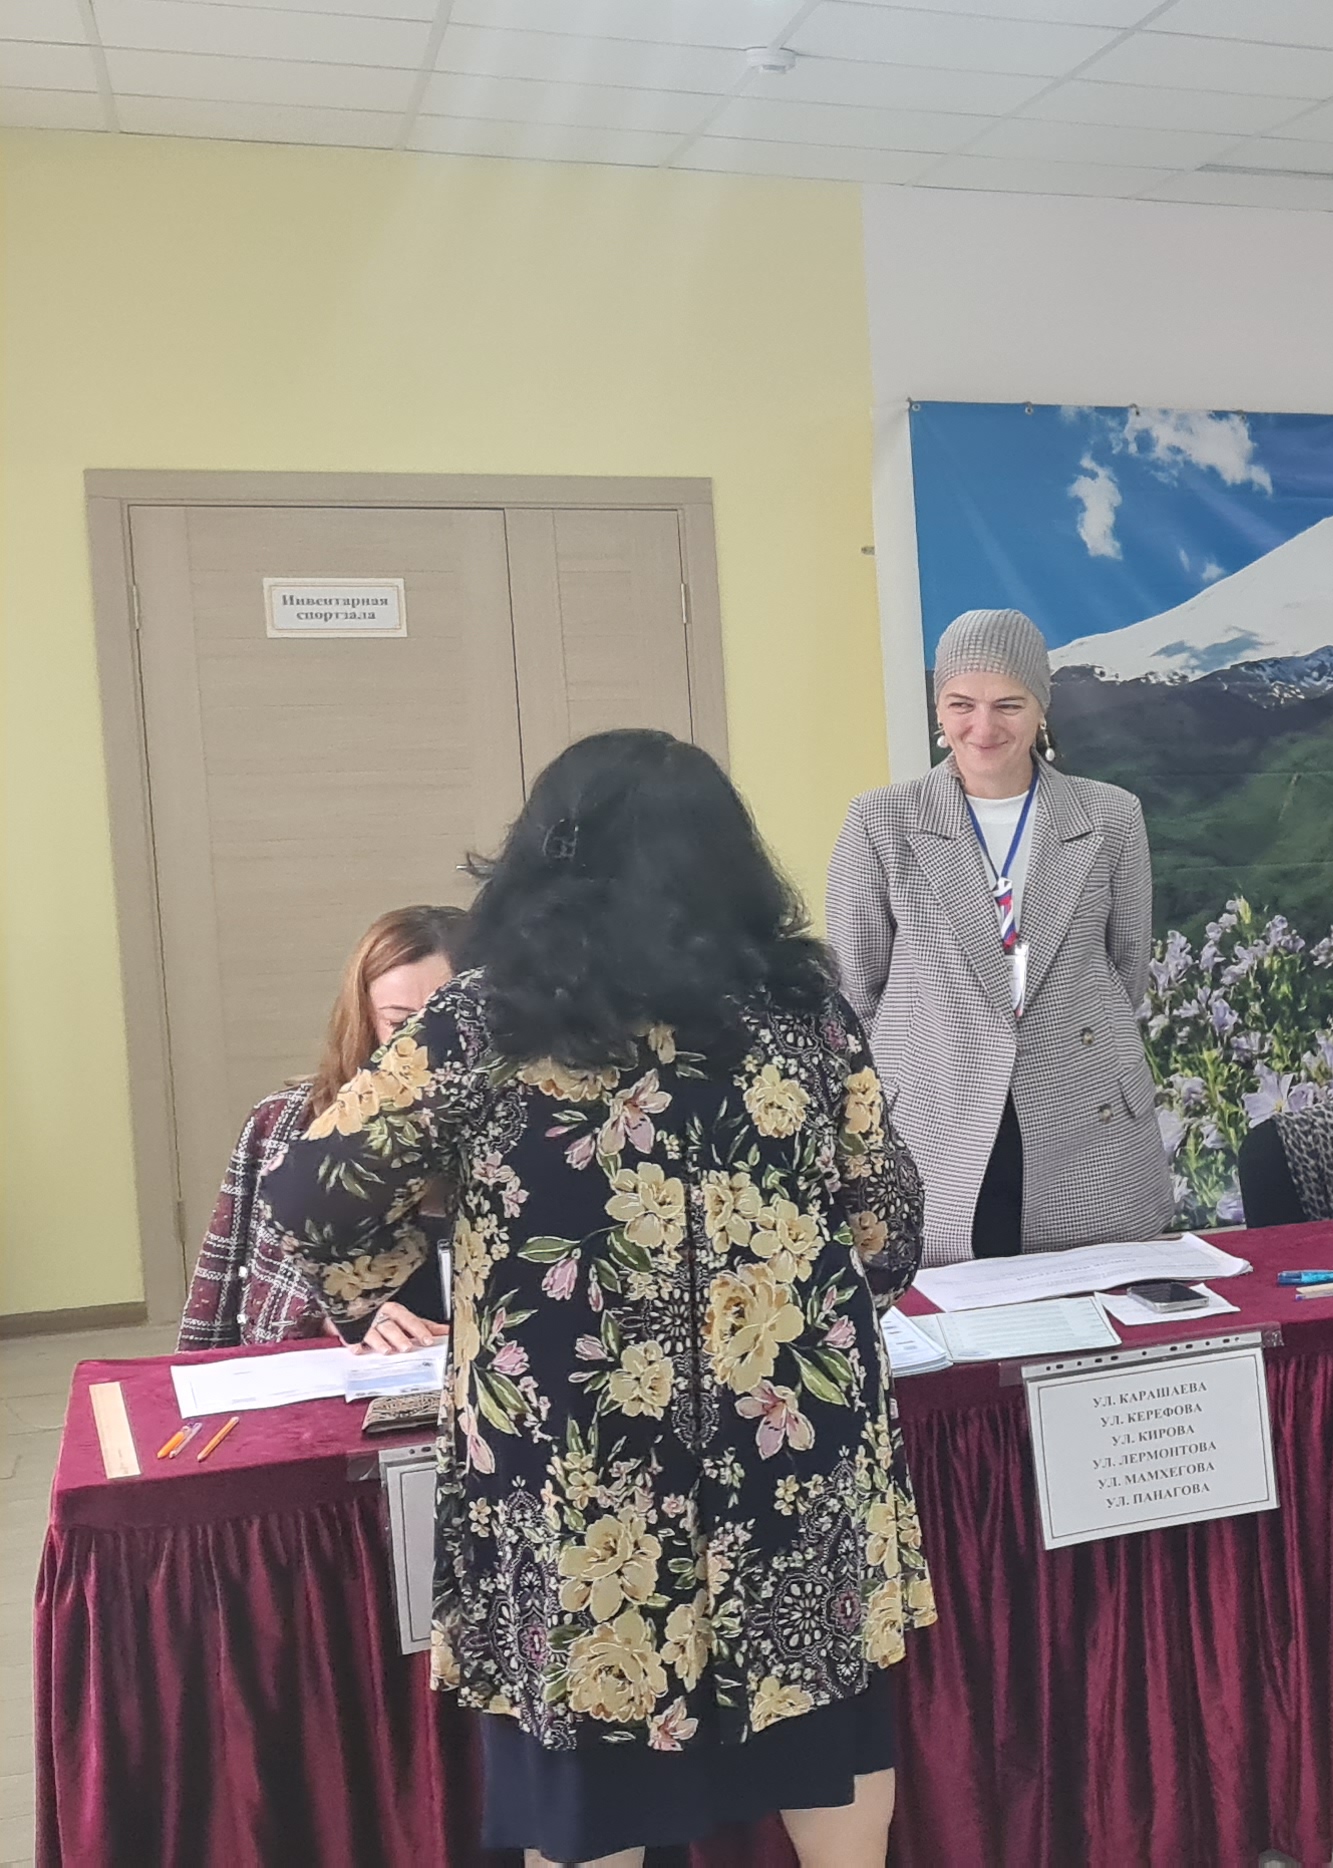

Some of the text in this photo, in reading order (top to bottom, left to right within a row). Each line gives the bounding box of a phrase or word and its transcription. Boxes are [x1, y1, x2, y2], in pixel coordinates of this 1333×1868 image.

[282, 594, 388, 608] Инвентарная
[296, 611, 376, 622] спортзала
[1092, 1382, 1208, 1408] УЛ. КАРАШАЕВА
[1100, 1403, 1203, 1428] УЛ. КЕРЕФОВА
[1111, 1424, 1195, 1446] УЛ. КИРОВА
[1092, 1441, 1217, 1470] УЛ. ЛЕРМОНТОВА
[1097, 1462, 1215, 1490] УЛ. МАМХЕГОВА
[1106, 1482, 1210, 1509] УЛ. ПАНАГОВА
